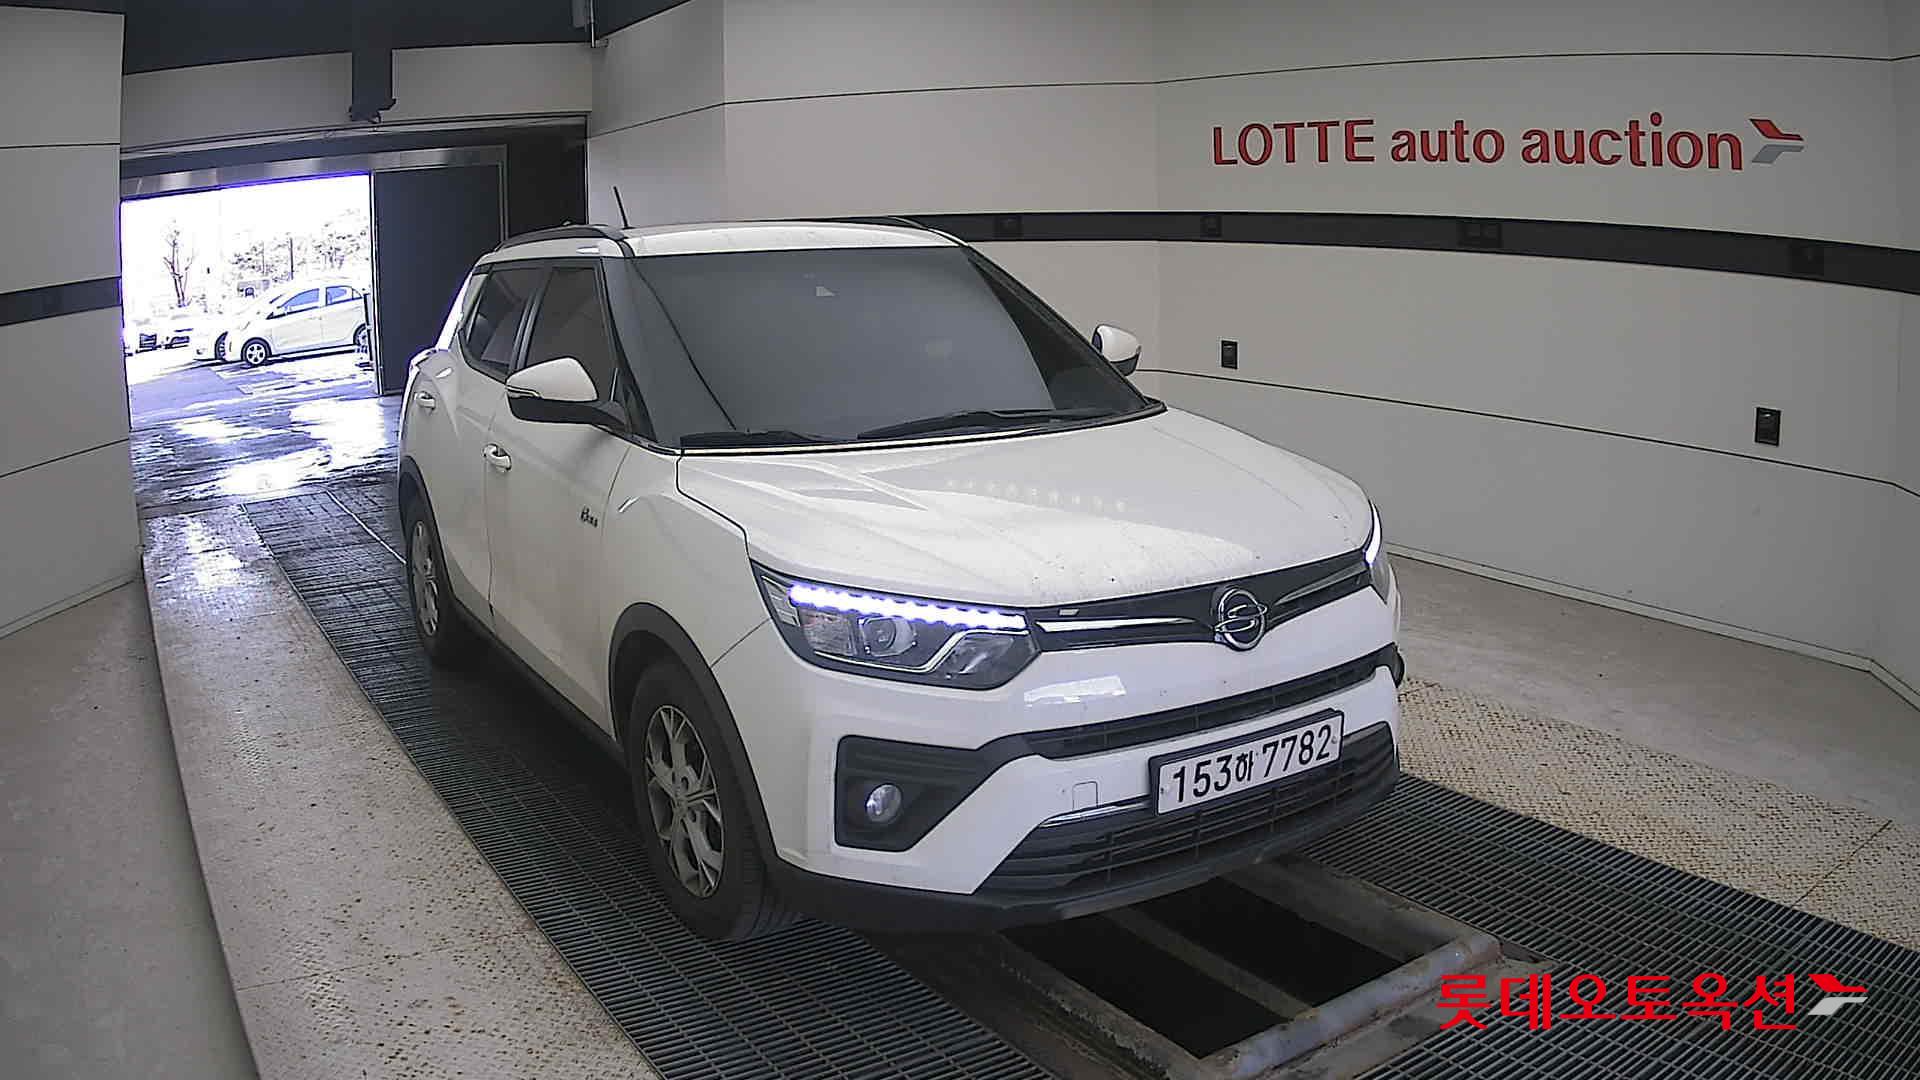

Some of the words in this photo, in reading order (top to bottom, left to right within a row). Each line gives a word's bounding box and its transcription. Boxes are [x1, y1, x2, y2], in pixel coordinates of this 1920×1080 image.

[1212, 119, 1375, 166] LOTTE
[1391, 120, 1505, 163] auto
[1521, 112, 1743, 170] auction
[1262, 724, 1332, 778] 7782
